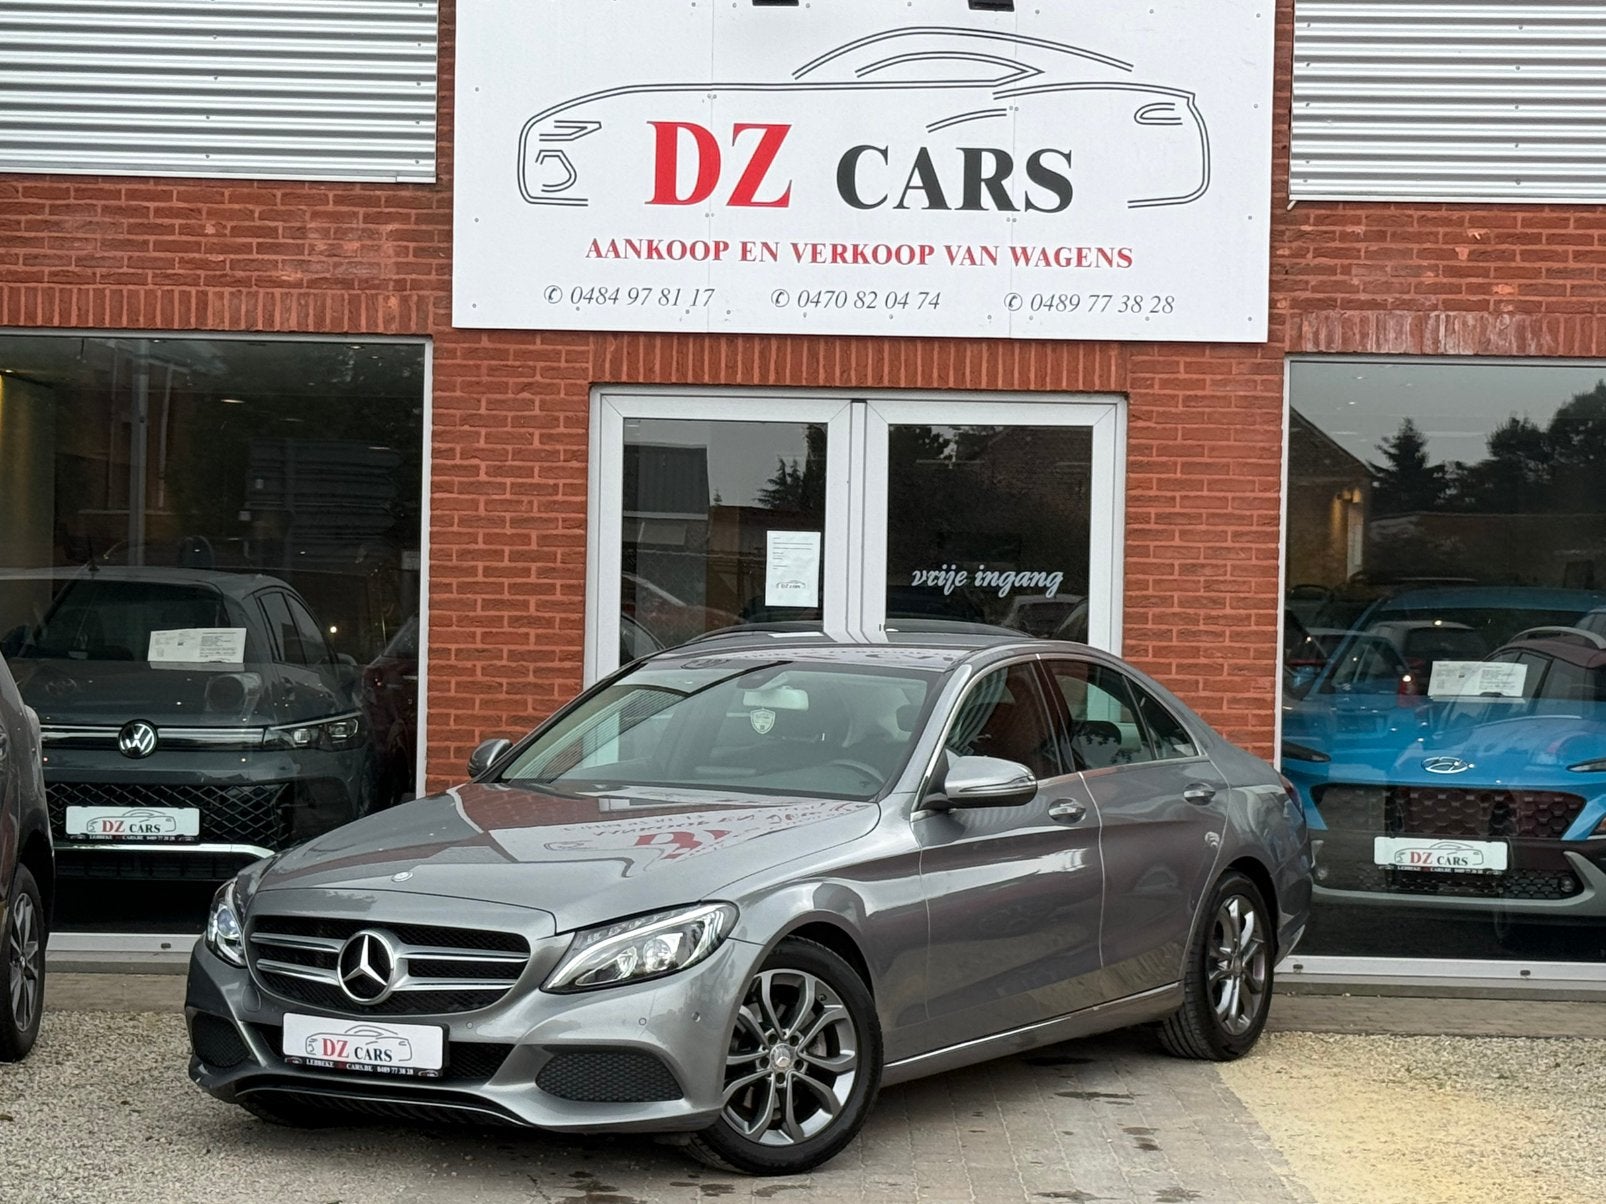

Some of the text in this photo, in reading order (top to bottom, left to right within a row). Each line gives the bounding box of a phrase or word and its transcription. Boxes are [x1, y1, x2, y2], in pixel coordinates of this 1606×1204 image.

[644, 121, 1074, 213] DZ CARS
[585, 238, 1133, 268] AANKOOP EN VERKOOP VAN WAGENS
[570, 286, 716, 307] 0484 97 81 17
[797, 290, 942, 310] 0470 82 04 74
[1030, 293, 1175, 314] 0489 77 38 28
[911, 564, 1064, 598] vrije ingang
[101, 820, 161, 833] DZ CARS
[1410, 851, 1468, 866] DZ CARS
[322, 1038, 393, 1063] DZ CARS
